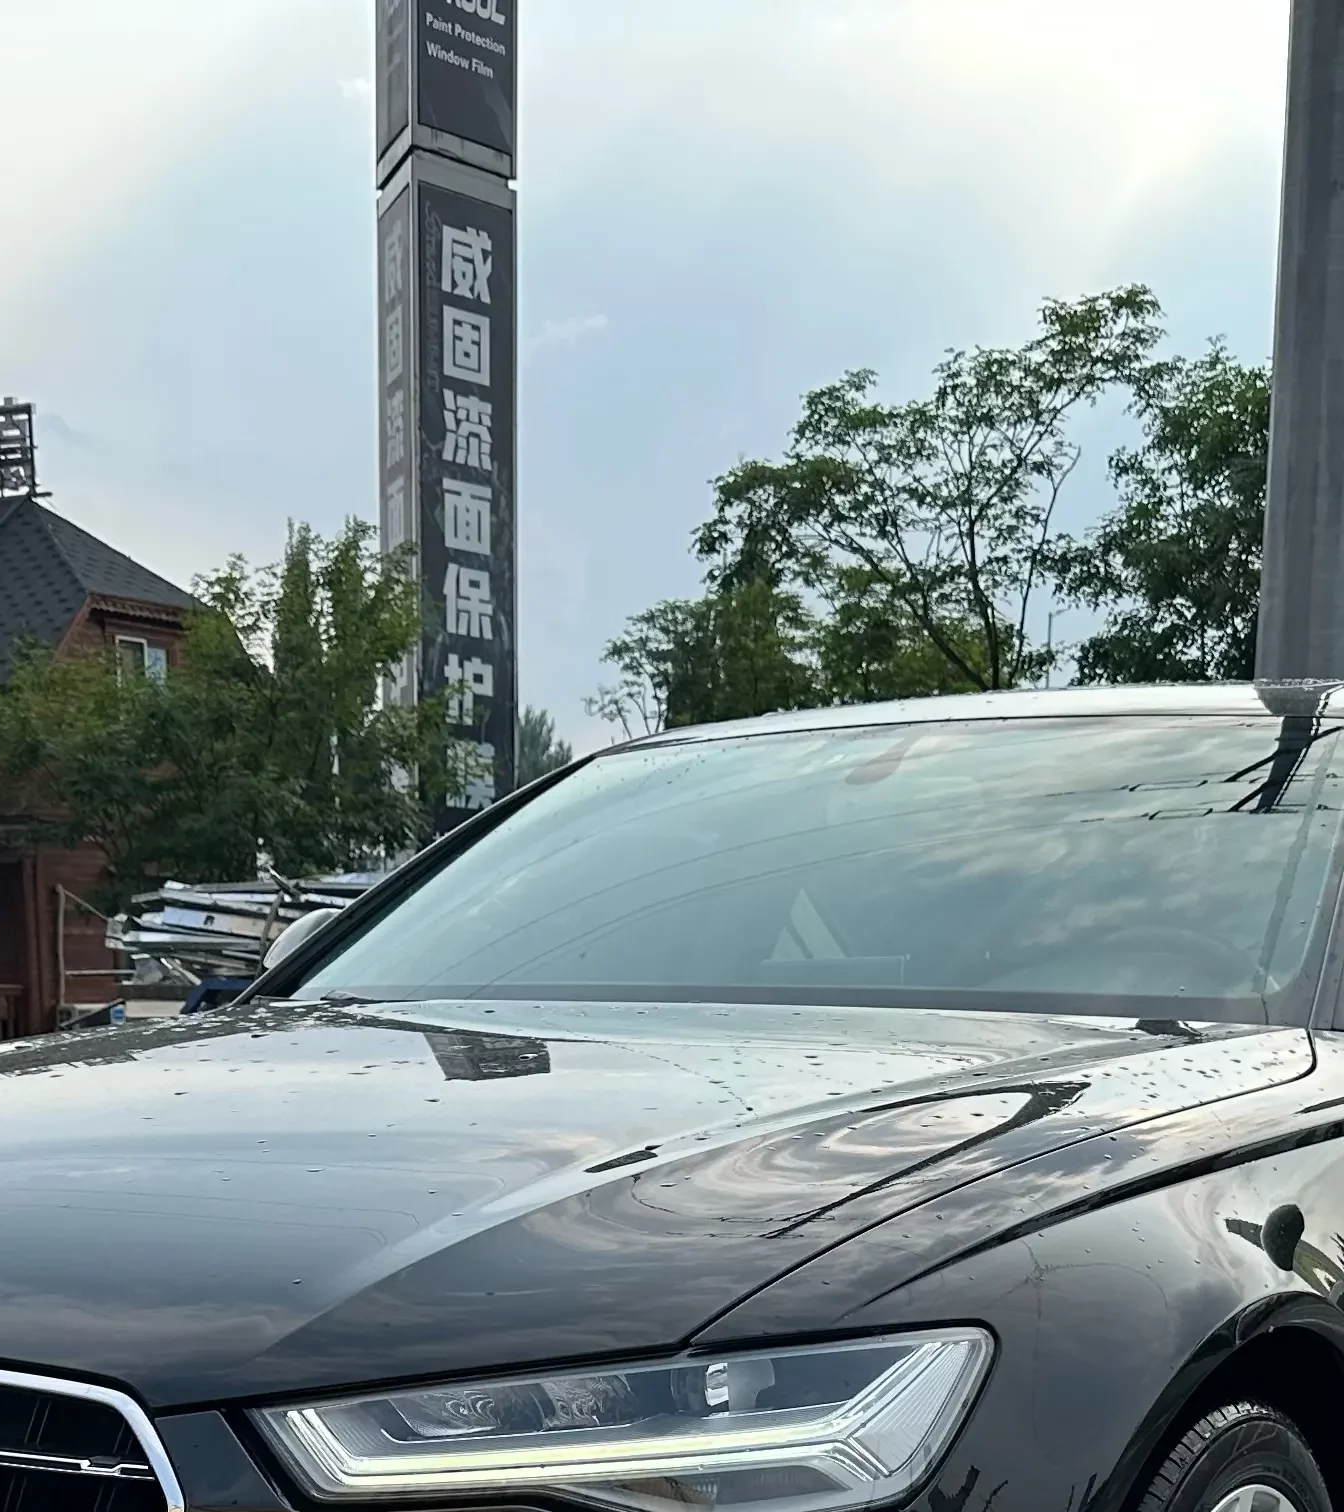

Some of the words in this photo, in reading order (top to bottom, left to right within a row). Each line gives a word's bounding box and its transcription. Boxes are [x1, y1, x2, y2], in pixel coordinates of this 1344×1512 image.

[425, 12, 453, 36] Paint
[454, 23, 506, 56] Protection
[426, 41, 470, 70] Window
[471, 57, 494, 79] Film
